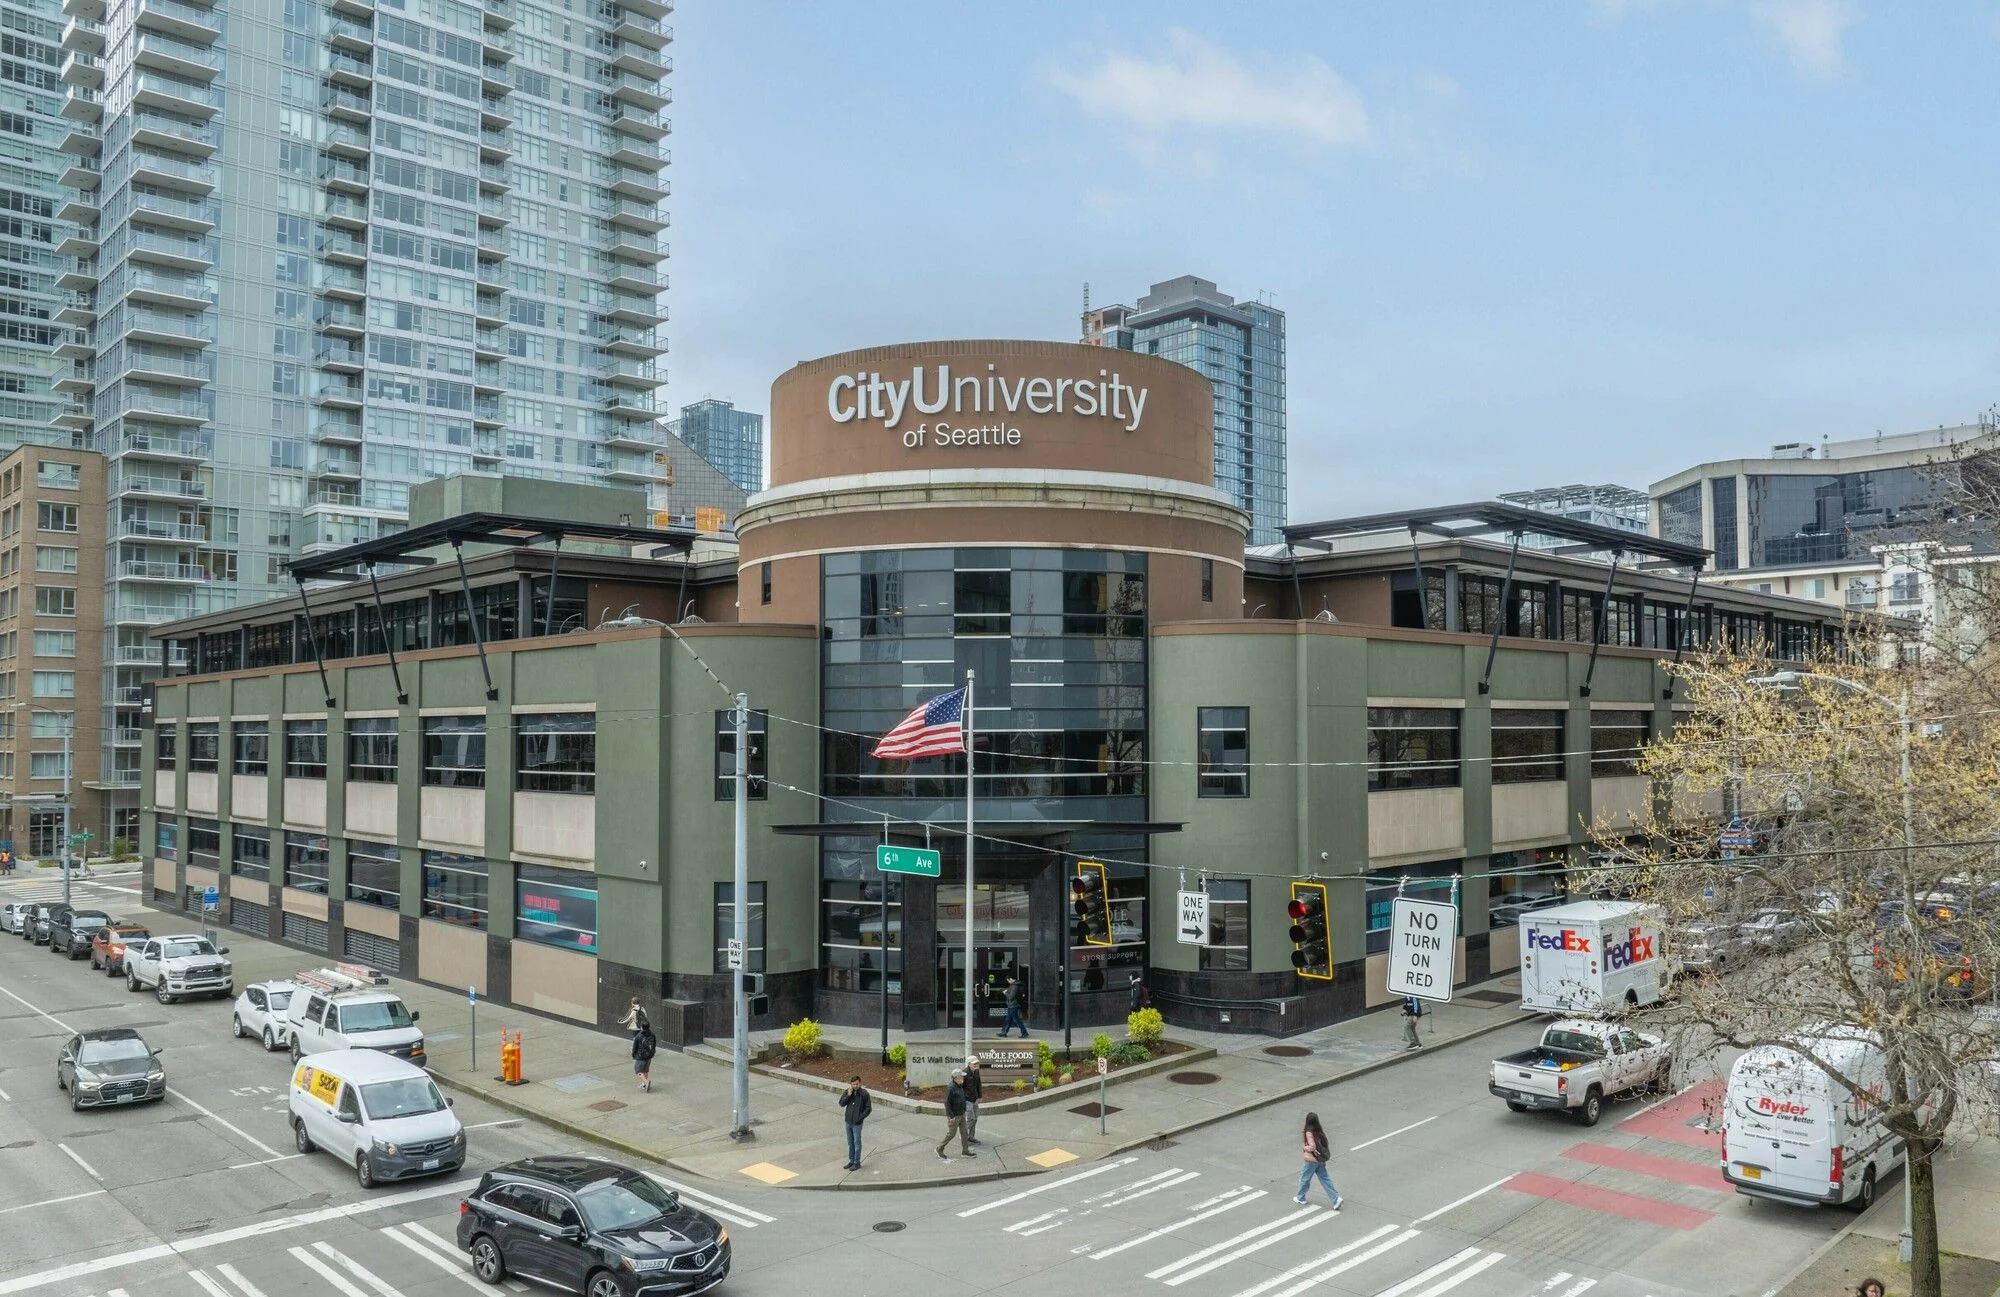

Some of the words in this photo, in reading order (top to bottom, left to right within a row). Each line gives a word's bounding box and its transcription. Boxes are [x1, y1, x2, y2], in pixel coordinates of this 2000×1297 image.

[828, 364, 1148, 432] CityUniversity
[903, 424, 927, 448] of
[935, 422, 1021, 446] Seattle
[884, 852, 899, 865] 6th
[916, 857, 932, 868] Ave
[1183, 896, 1203, 908] ONE
[1183, 910, 1204, 922] WAY
[1409, 911, 1438, 930] NO
[730, 941, 742, 949] ONE
[1404, 933, 1440, 951] TURN
[1527, 928, 1591, 952] FedEx
[1108, 951, 1137, 960] SUPPORT
[1602, 927, 1653, 973] FedEx
[1411, 953, 1430, 968] ON
[1406, 971, 1433, 987] RED
[912, 1056, 925, 1064] 521
[927, 1056, 943, 1064] Wall
[979, 1051, 1006, 1060] WHOLE
[1008, 1051, 1033, 1059] FOODS
[1759, 1097, 1809, 1116] Ryder
